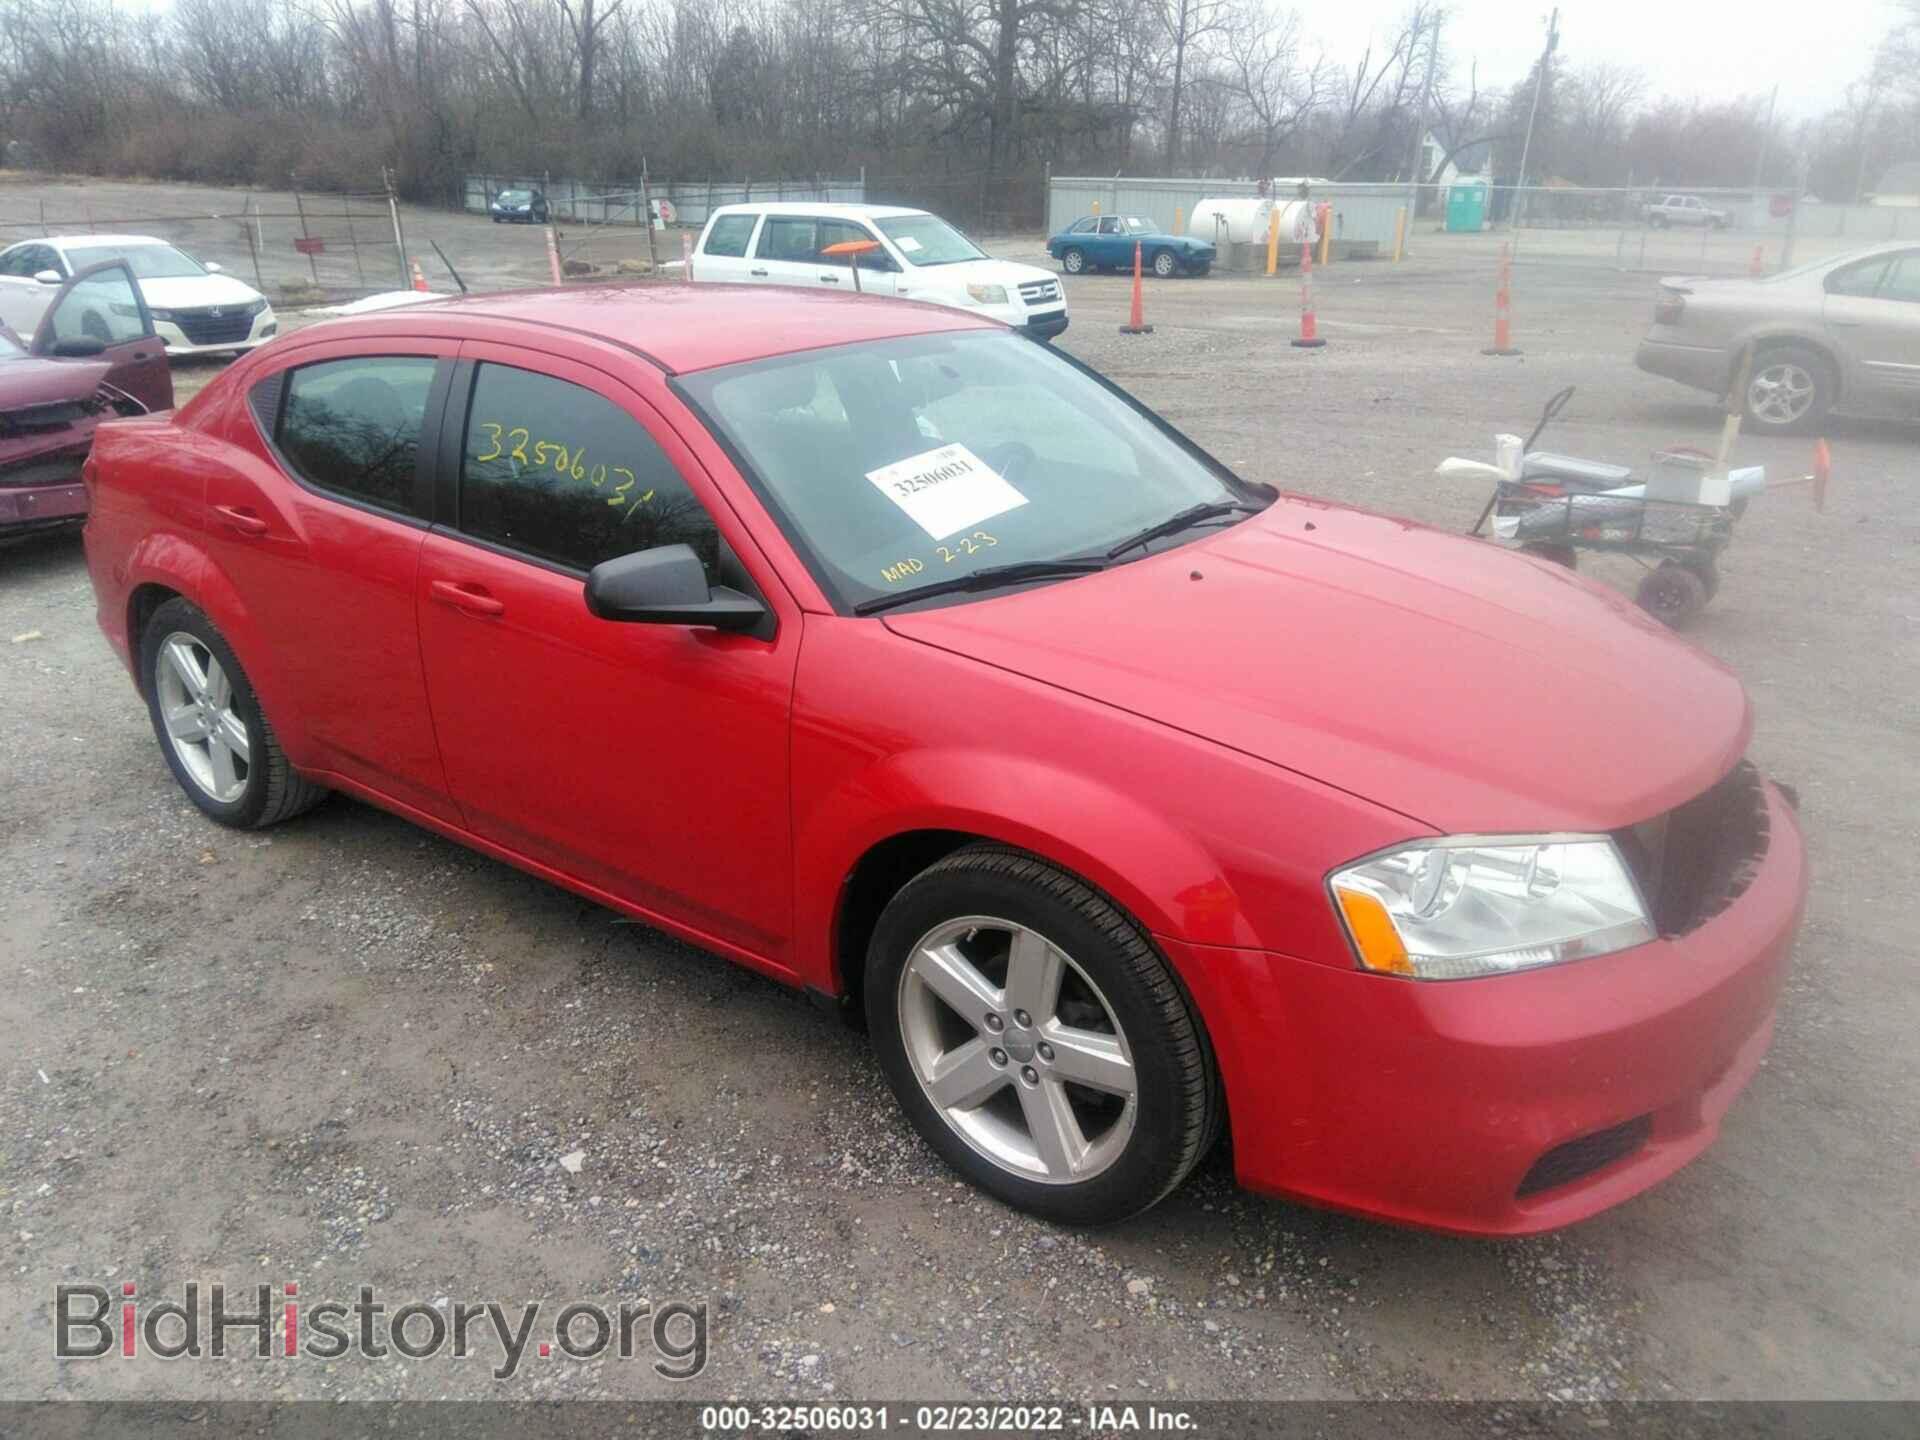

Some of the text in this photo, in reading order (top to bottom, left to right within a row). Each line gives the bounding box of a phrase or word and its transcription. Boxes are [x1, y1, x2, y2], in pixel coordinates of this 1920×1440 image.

[478, 424, 655, 523] 32506031
[893, 460, 973, 496] 32506031
[881, 531, 998, 582] MAD 2-23
